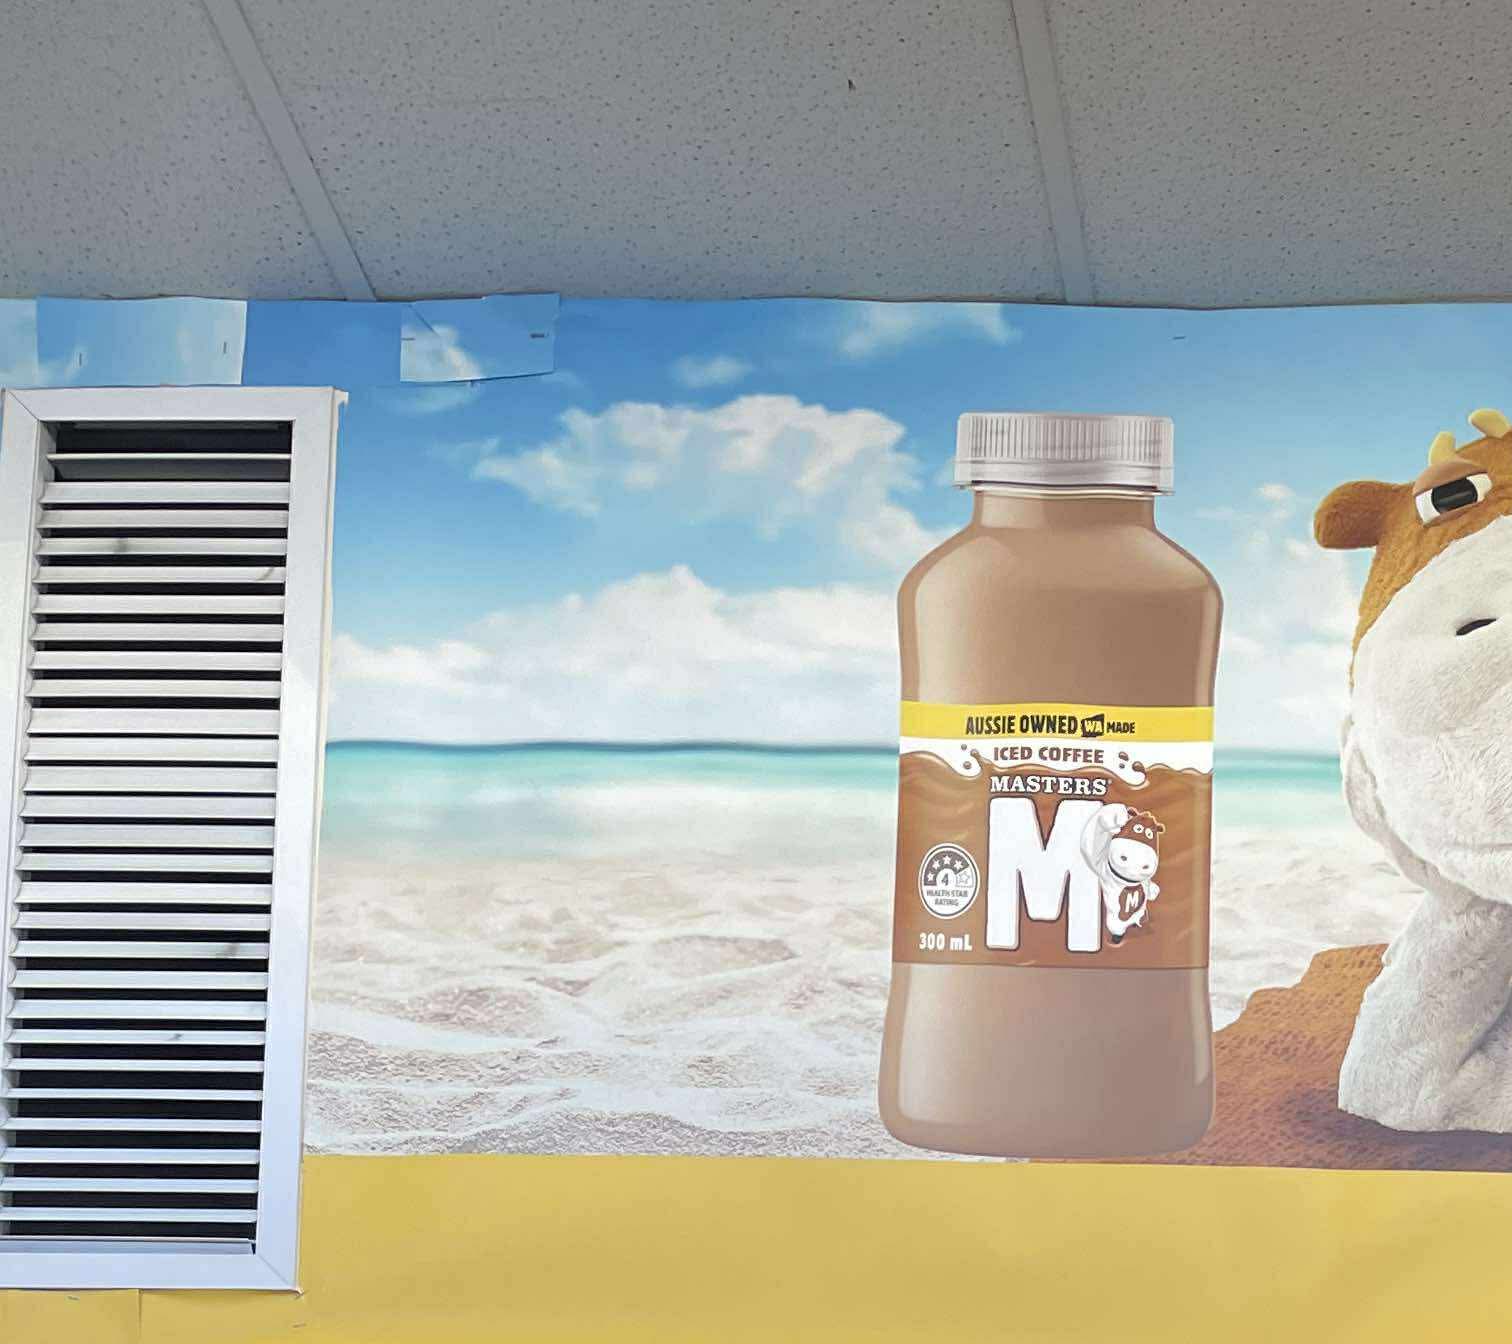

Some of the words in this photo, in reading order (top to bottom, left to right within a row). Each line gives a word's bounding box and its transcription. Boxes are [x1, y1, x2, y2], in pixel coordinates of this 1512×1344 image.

[965, 715, 1015, 735] AUSSIE
[1019, 715, 1078, 734] OWNED
[1106, 721, 1136, 734] MADE
[993, 746, 1033, 762] ICED
[1038, 746, 1105, 764] COFFEE
[989, 775, 1108, 796] MASTERS
[941, 873, 949, 886] 4
[985, 796, 1104, 952] M
[1125, 890, 1141, 913] M
[919, 932, 945, 950] 300
[950, 934, 973, 951] mL
